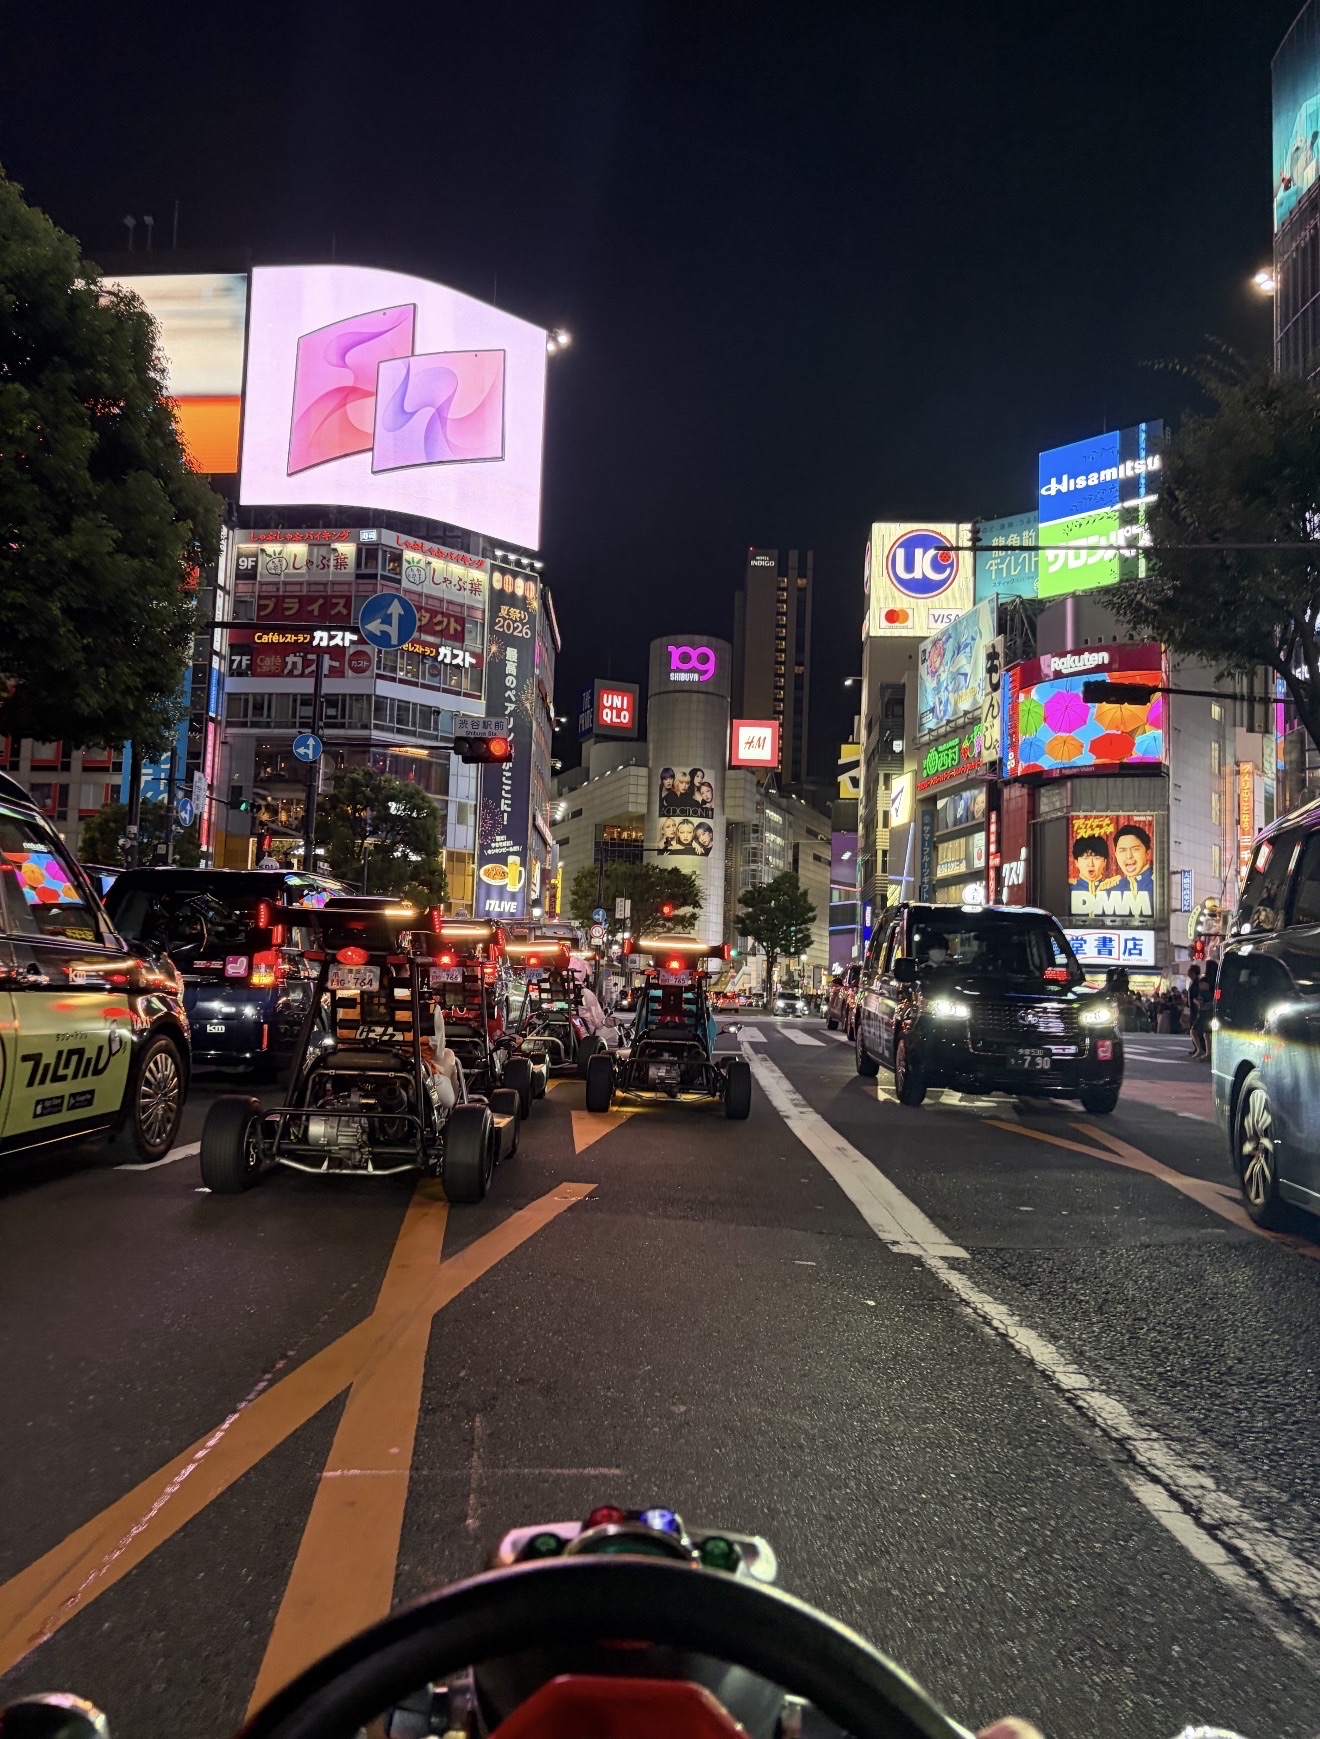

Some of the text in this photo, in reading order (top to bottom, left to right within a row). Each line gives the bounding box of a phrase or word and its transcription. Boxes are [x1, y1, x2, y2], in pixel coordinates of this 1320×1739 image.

[1040, 454, 1161, 496] Hisamitsu
[250, 530, 350, 542] しゃぶしゃぶバイキング
[396, 535, 486, 568] しゃぶしゃぶバイキング
[238, 557, 256, 570] 9F
[292, 553, 349, 571] しゃぶ葉
[985, 552, 1039, 580] ダイレクト
[431, 567, 483, 596] しゃぶ葉
[499, 605, 529, 622] 夏祭り
[494, 618, 531, 638] 2026
[231, 656, 251, 669] 7F
[257, 655, 282, 666] Café
[283, 652, 340, 675] ガスト
[437, 646, 477, 668] ガスト
[667, 645, 716, 682] 109
[1050, 651, 1110, 673] Rakuten
[669, 672, 699, 682] SHIBUYA
[602, 694, 627, 709] UNI
[984, 642, 1000, 756] もんじゃ
[602, 708, 629, 723] QLO
[458, 720, 504, 731] 渋谷駅前
[744, 735, 766, 750] H&M
[922, 825, 931, 900] サマーフルーツギフト
[485, 899, 518, 913] 17LIVE
[1070, 890, 1152, 915] DMM
